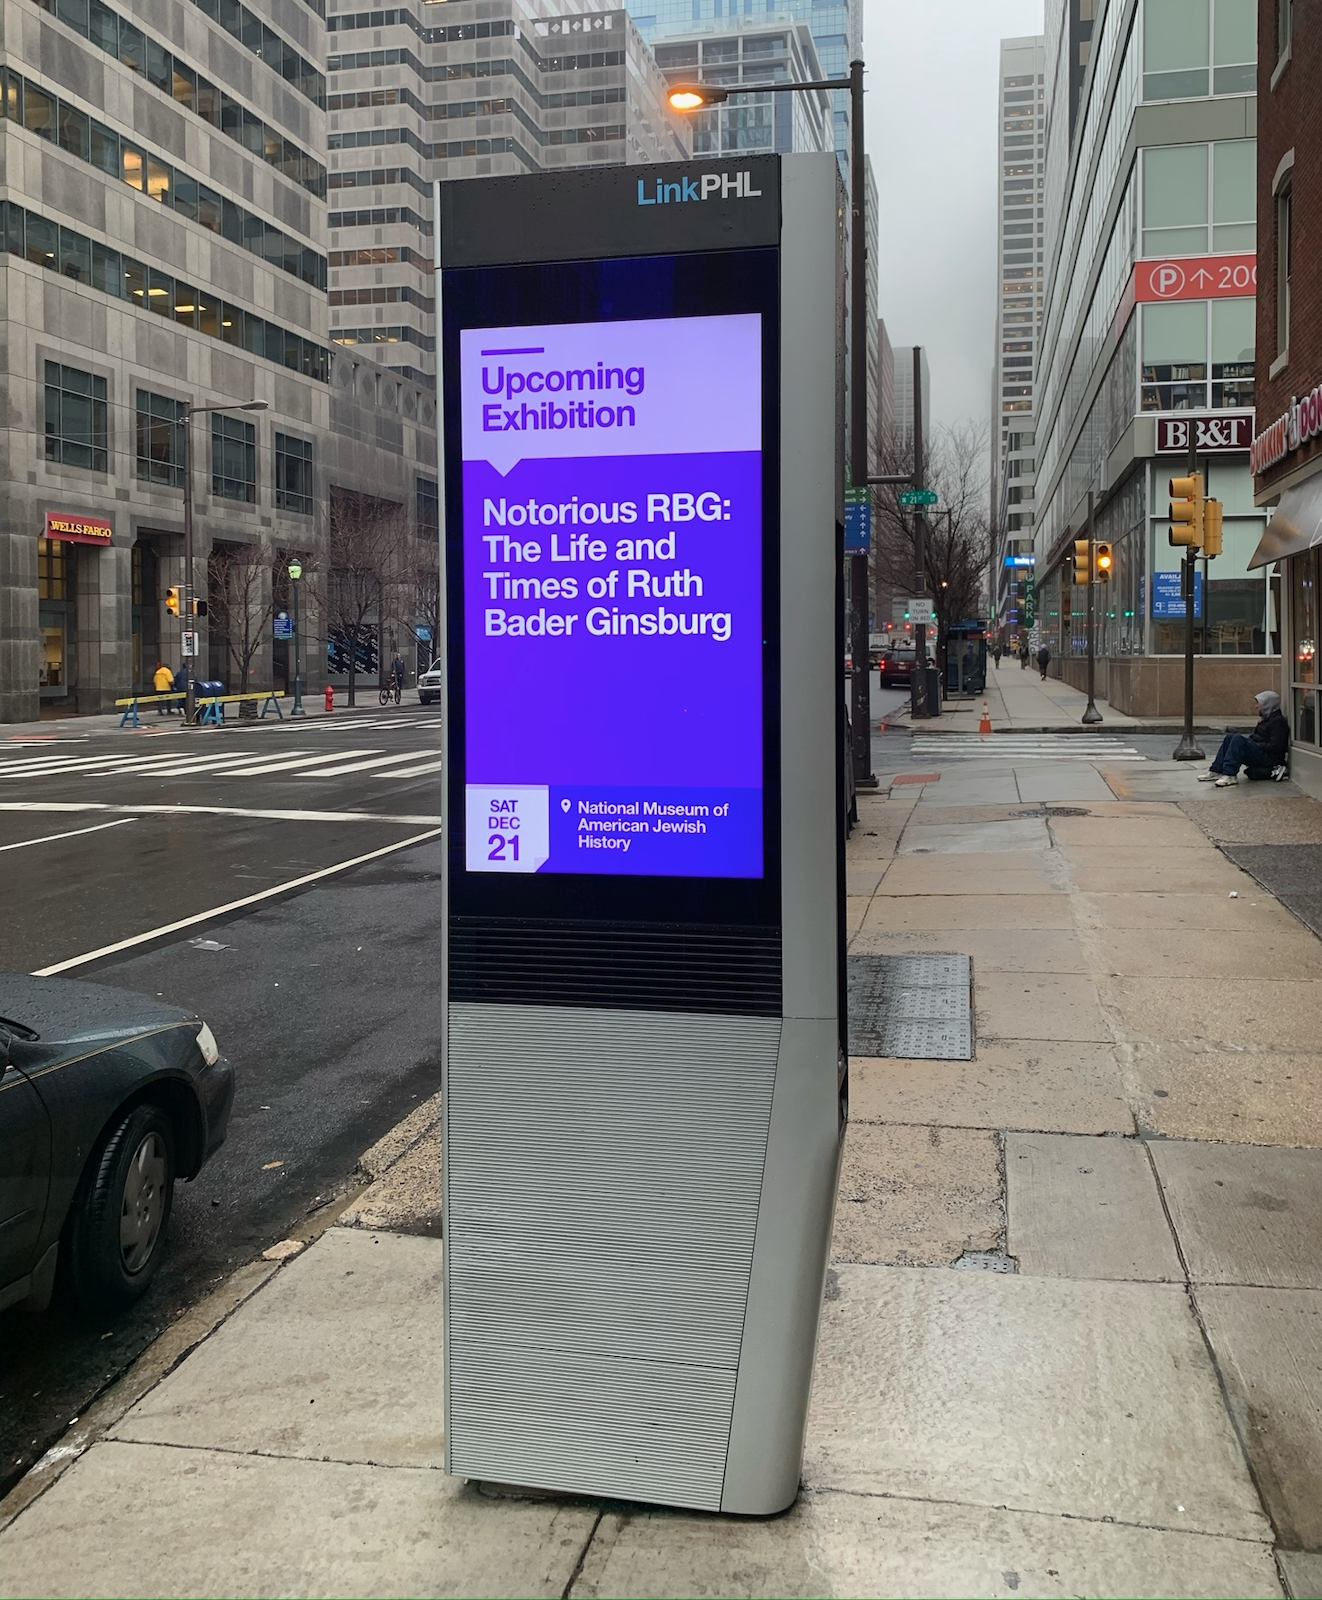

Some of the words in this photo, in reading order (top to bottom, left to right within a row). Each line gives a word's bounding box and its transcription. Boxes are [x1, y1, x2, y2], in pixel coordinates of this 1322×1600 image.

[638, 171, 762, 205] LinkPHL
[1218, 265, 1257, 289] 20
[482, 361, 645, 400] Upcoming
[483, 400, 635, 431] Exhibition
[1164, 419, 1246, 447] BB&T
[483, 496, 638, 526] Notorious
[647, 491, 731, 522] RBG:
[51, 520, 82, 534] WELLS
[83, 525, 112, 538] FARGO
[482, 535, 541, 563] The
[551, 533, 607, 561] Life
[615, 531, 675, 560] and
[483, 571, 579, 599] Times
[587, 570, 619, 598] of
[628, 568, 703, 598] Ruth
[1025, 584, 1034, 619] PARK
[485, 608, 578, 636] Bader
[586, 606, 732, 641] Ginsburg
[490, 799, 518, 813] SAT
[578, 800, 639, 815] National
[643, 801, 709, 817] Museum
[713, 803, 729, 817] of
[488, 816, 520, 829] DEC
[578, 818, 649, 832] American
[652, 818, 706, 833] Jewish
[488, 834, 519, 861] 21
[578, 835, 631, 852] History
